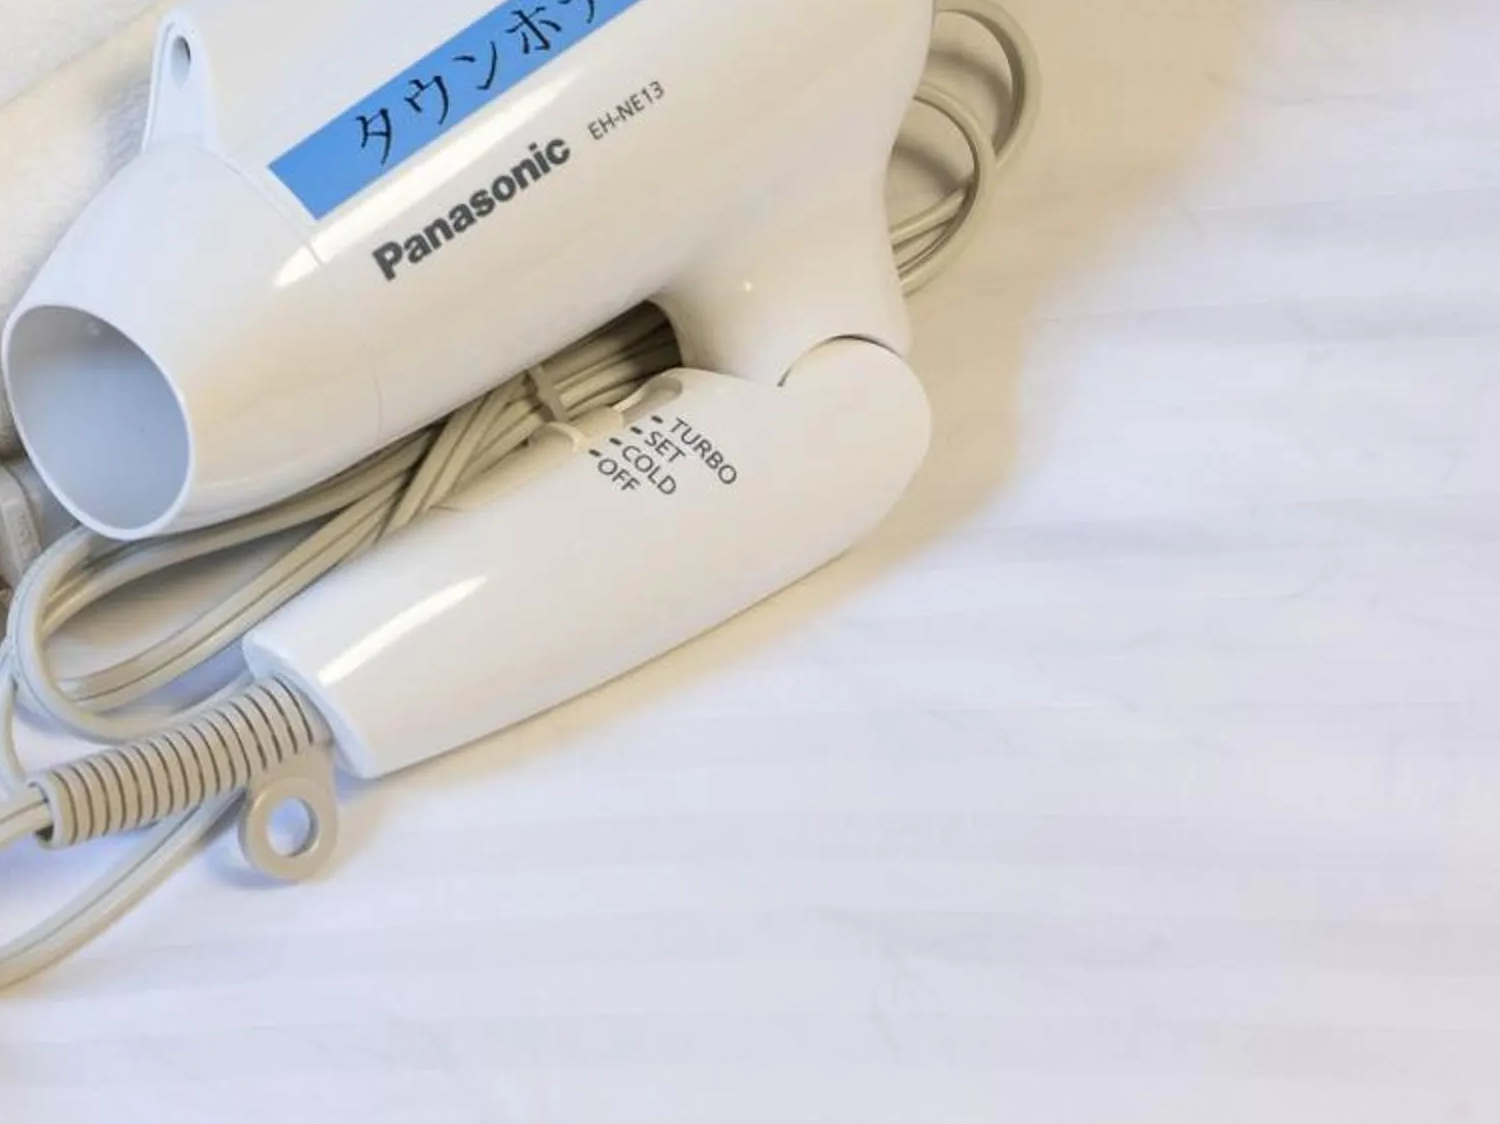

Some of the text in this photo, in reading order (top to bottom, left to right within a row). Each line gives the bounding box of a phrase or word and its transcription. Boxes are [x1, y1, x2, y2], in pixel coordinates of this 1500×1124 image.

[372, 80, 665, 281] Panasonic EH-NE13
[622, 445, 677, 495] COLD
[644, 431, 687, 463] SET
[670, 416, 737, 485] TURBO
[597, 458, 641, 491] OFF
